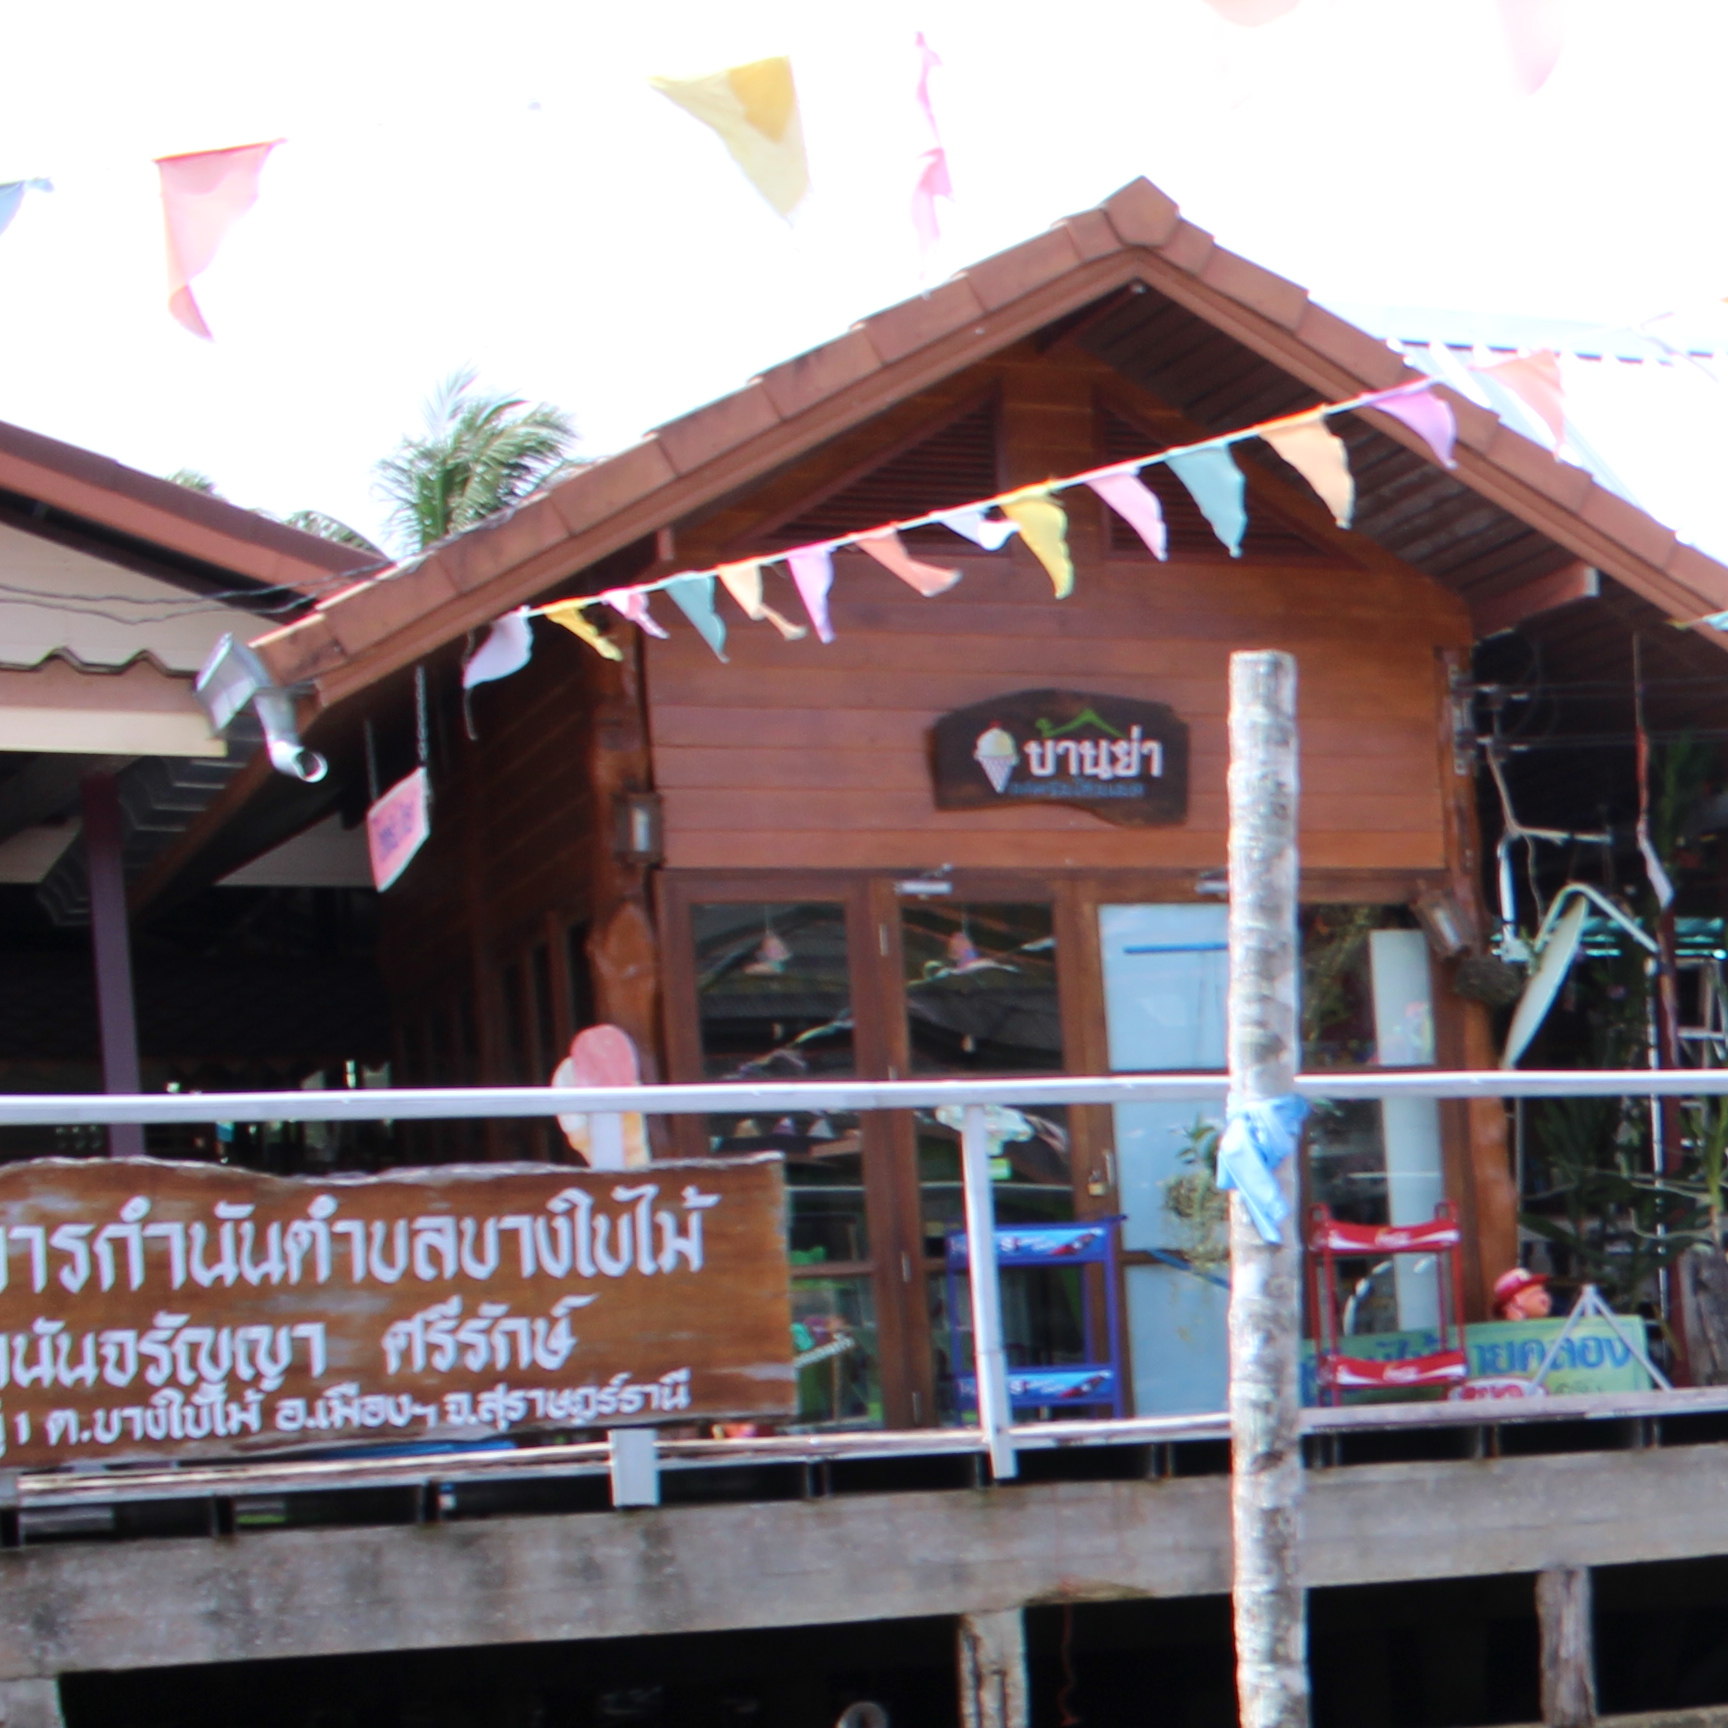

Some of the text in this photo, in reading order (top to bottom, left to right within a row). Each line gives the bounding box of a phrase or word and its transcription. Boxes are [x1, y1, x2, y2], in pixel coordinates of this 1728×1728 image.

[0, 1184, 720, 1293] ารกำนันตำบลบางใบไม้
[0, 1293, 598, 1393] นันจรัญญา ศรีรักษ์
[443, 1367, 692, 1433] จ.สุราษฎร์ธานี
